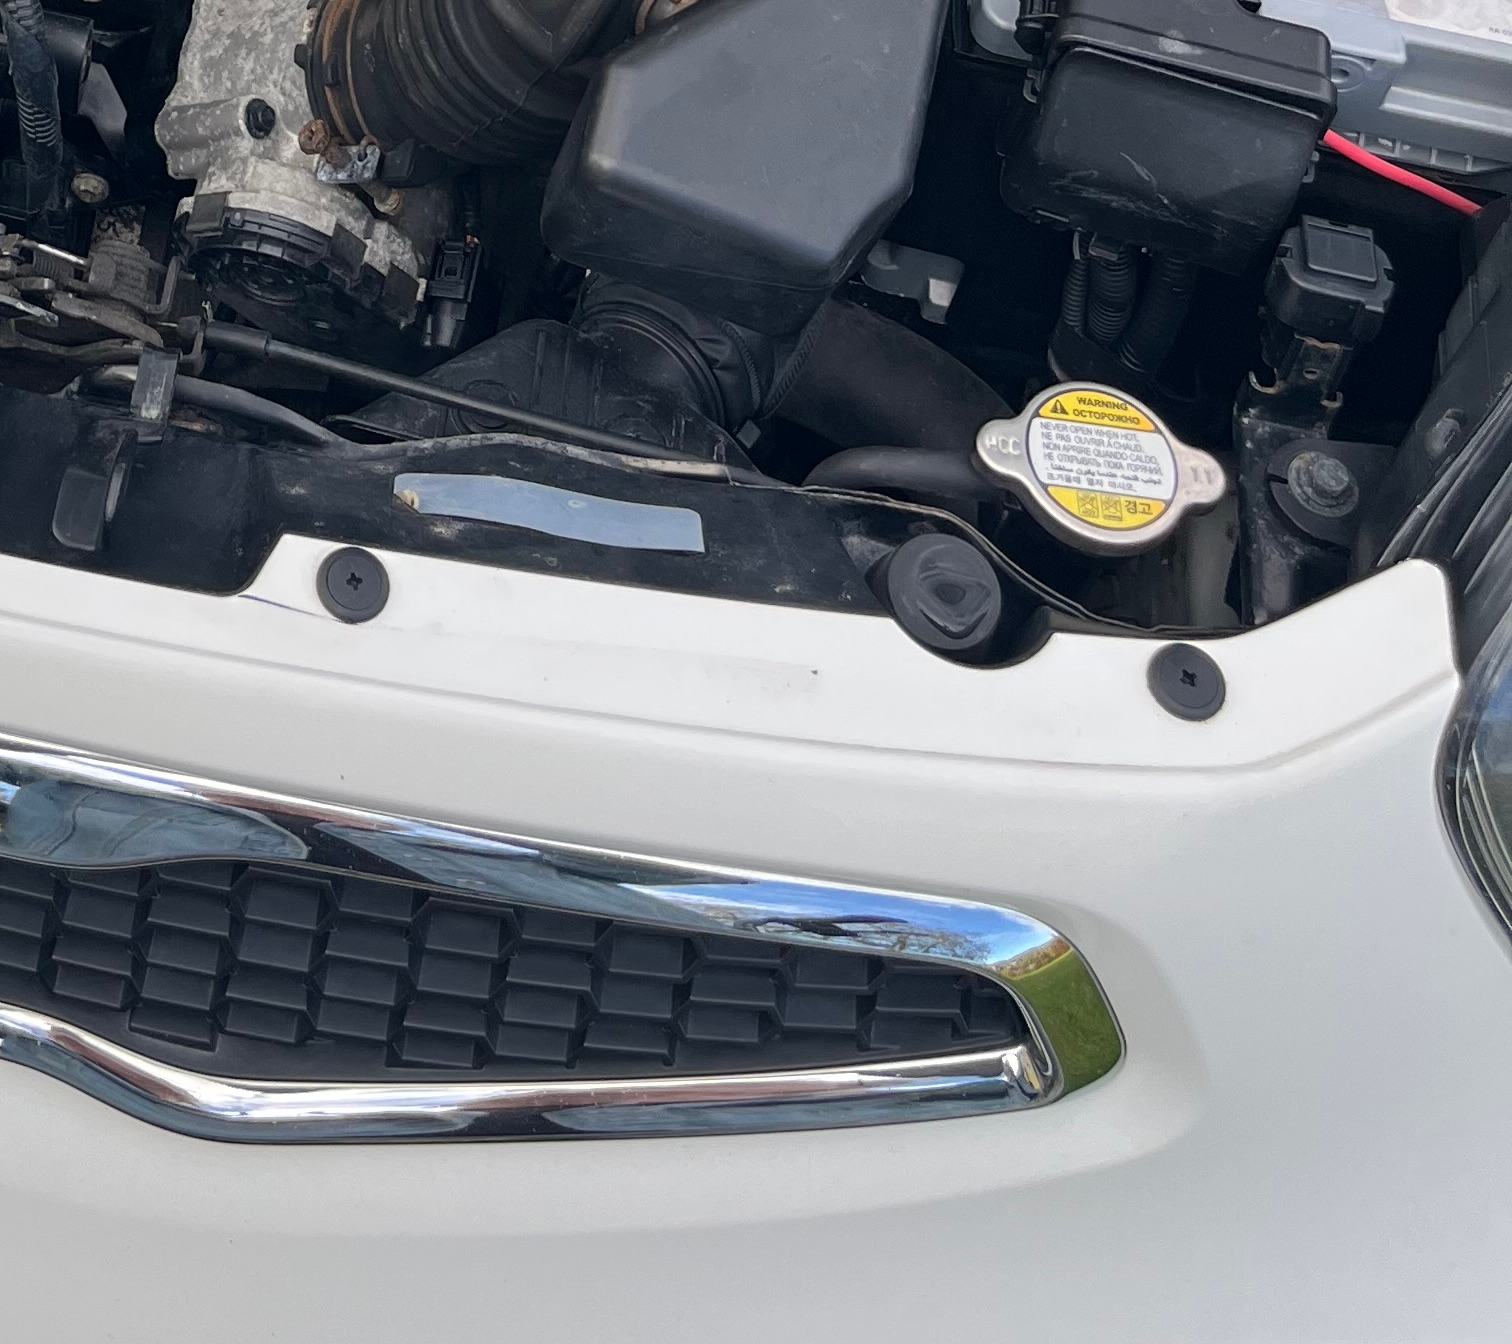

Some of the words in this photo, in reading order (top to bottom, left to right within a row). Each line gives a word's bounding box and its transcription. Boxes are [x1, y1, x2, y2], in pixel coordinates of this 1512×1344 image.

[1076, 396, 1128, 410] WARNING
[1073, 409, 1140, 425] ОСТОРОЖНО
[1040, 422, 1068, 431] NEVER
[1070, 425, 1093, 435] OPEN
[1094, 427, 1119, 438] WHEN
[1041, 432, 1052, 440] NE
[1056, 433, 1071, 442] PAS
[1074, 435, 1104, 447] OUVRIR
[1043, 442, 1061, 451] NON
[1063, 445, 1091, 455] APRIRE
[1093, 448, 1128, 460] QUANDO
[1124, 499, 1153, 515] 경고
